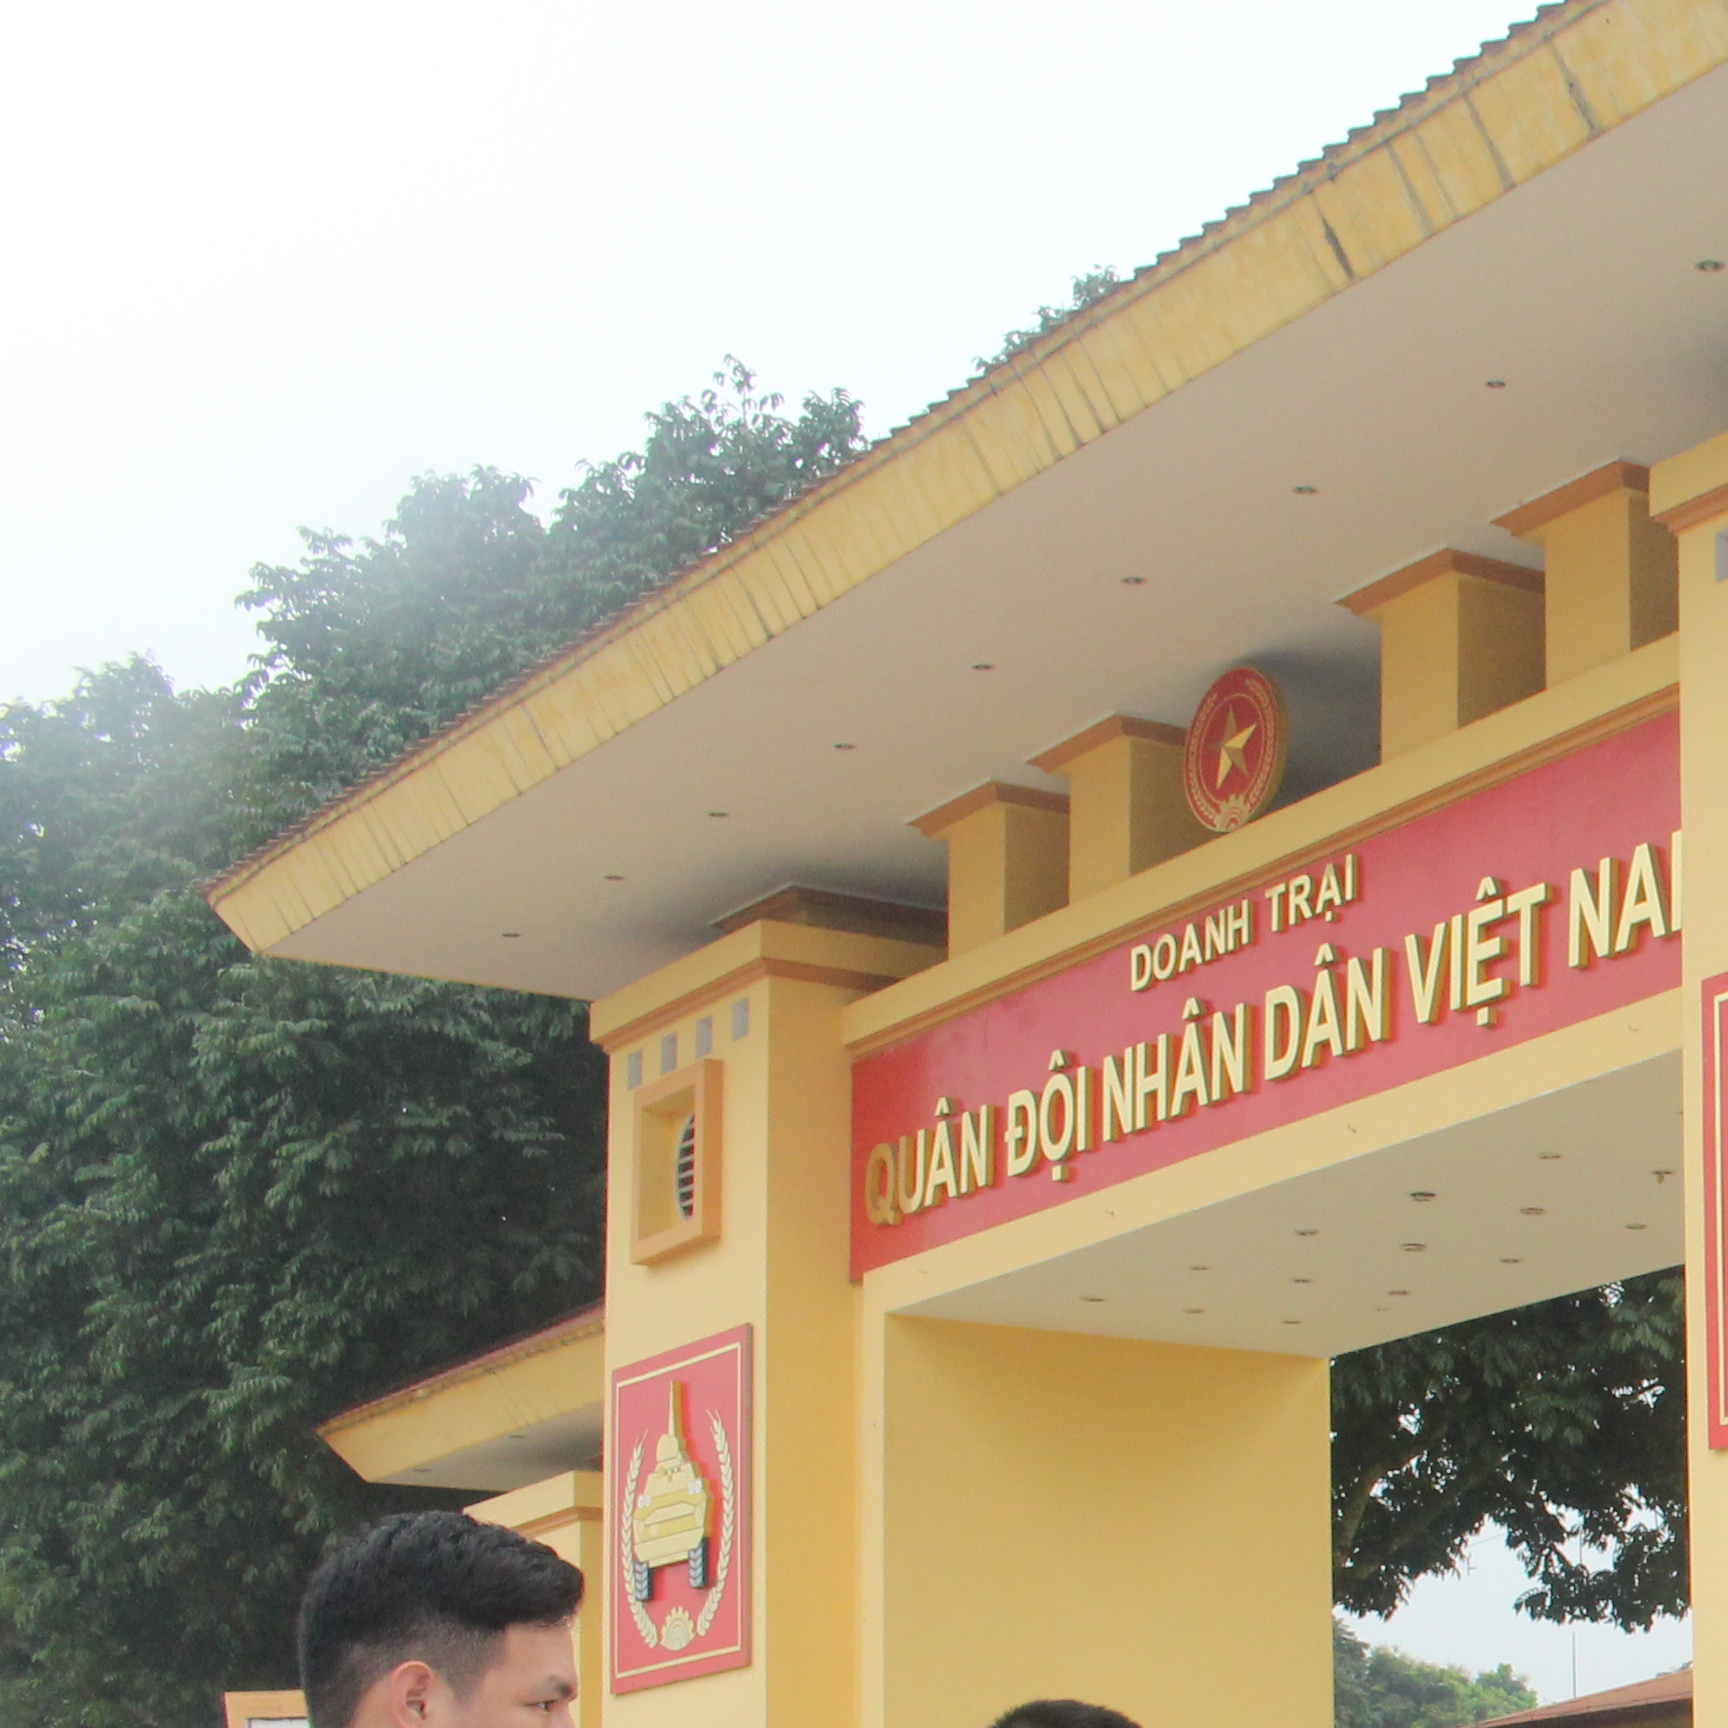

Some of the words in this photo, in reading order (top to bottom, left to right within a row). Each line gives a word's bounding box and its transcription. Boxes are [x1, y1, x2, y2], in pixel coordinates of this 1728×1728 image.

[865, 1096, 996, 1226] QUÂN
[1004, 1049, 1094, 1184] ĐỘI
[1102, 997, 1251, 1143] NHÂN
[1265, 944, 1390, 1082] DÂN
[1405, 876, 1551, 1027] VIỆT
[1568, 829, 1682, 970] NA
[1130, 900, 1252, 992] DOANH
[1265, 853, 1357, 932] TRẠI
